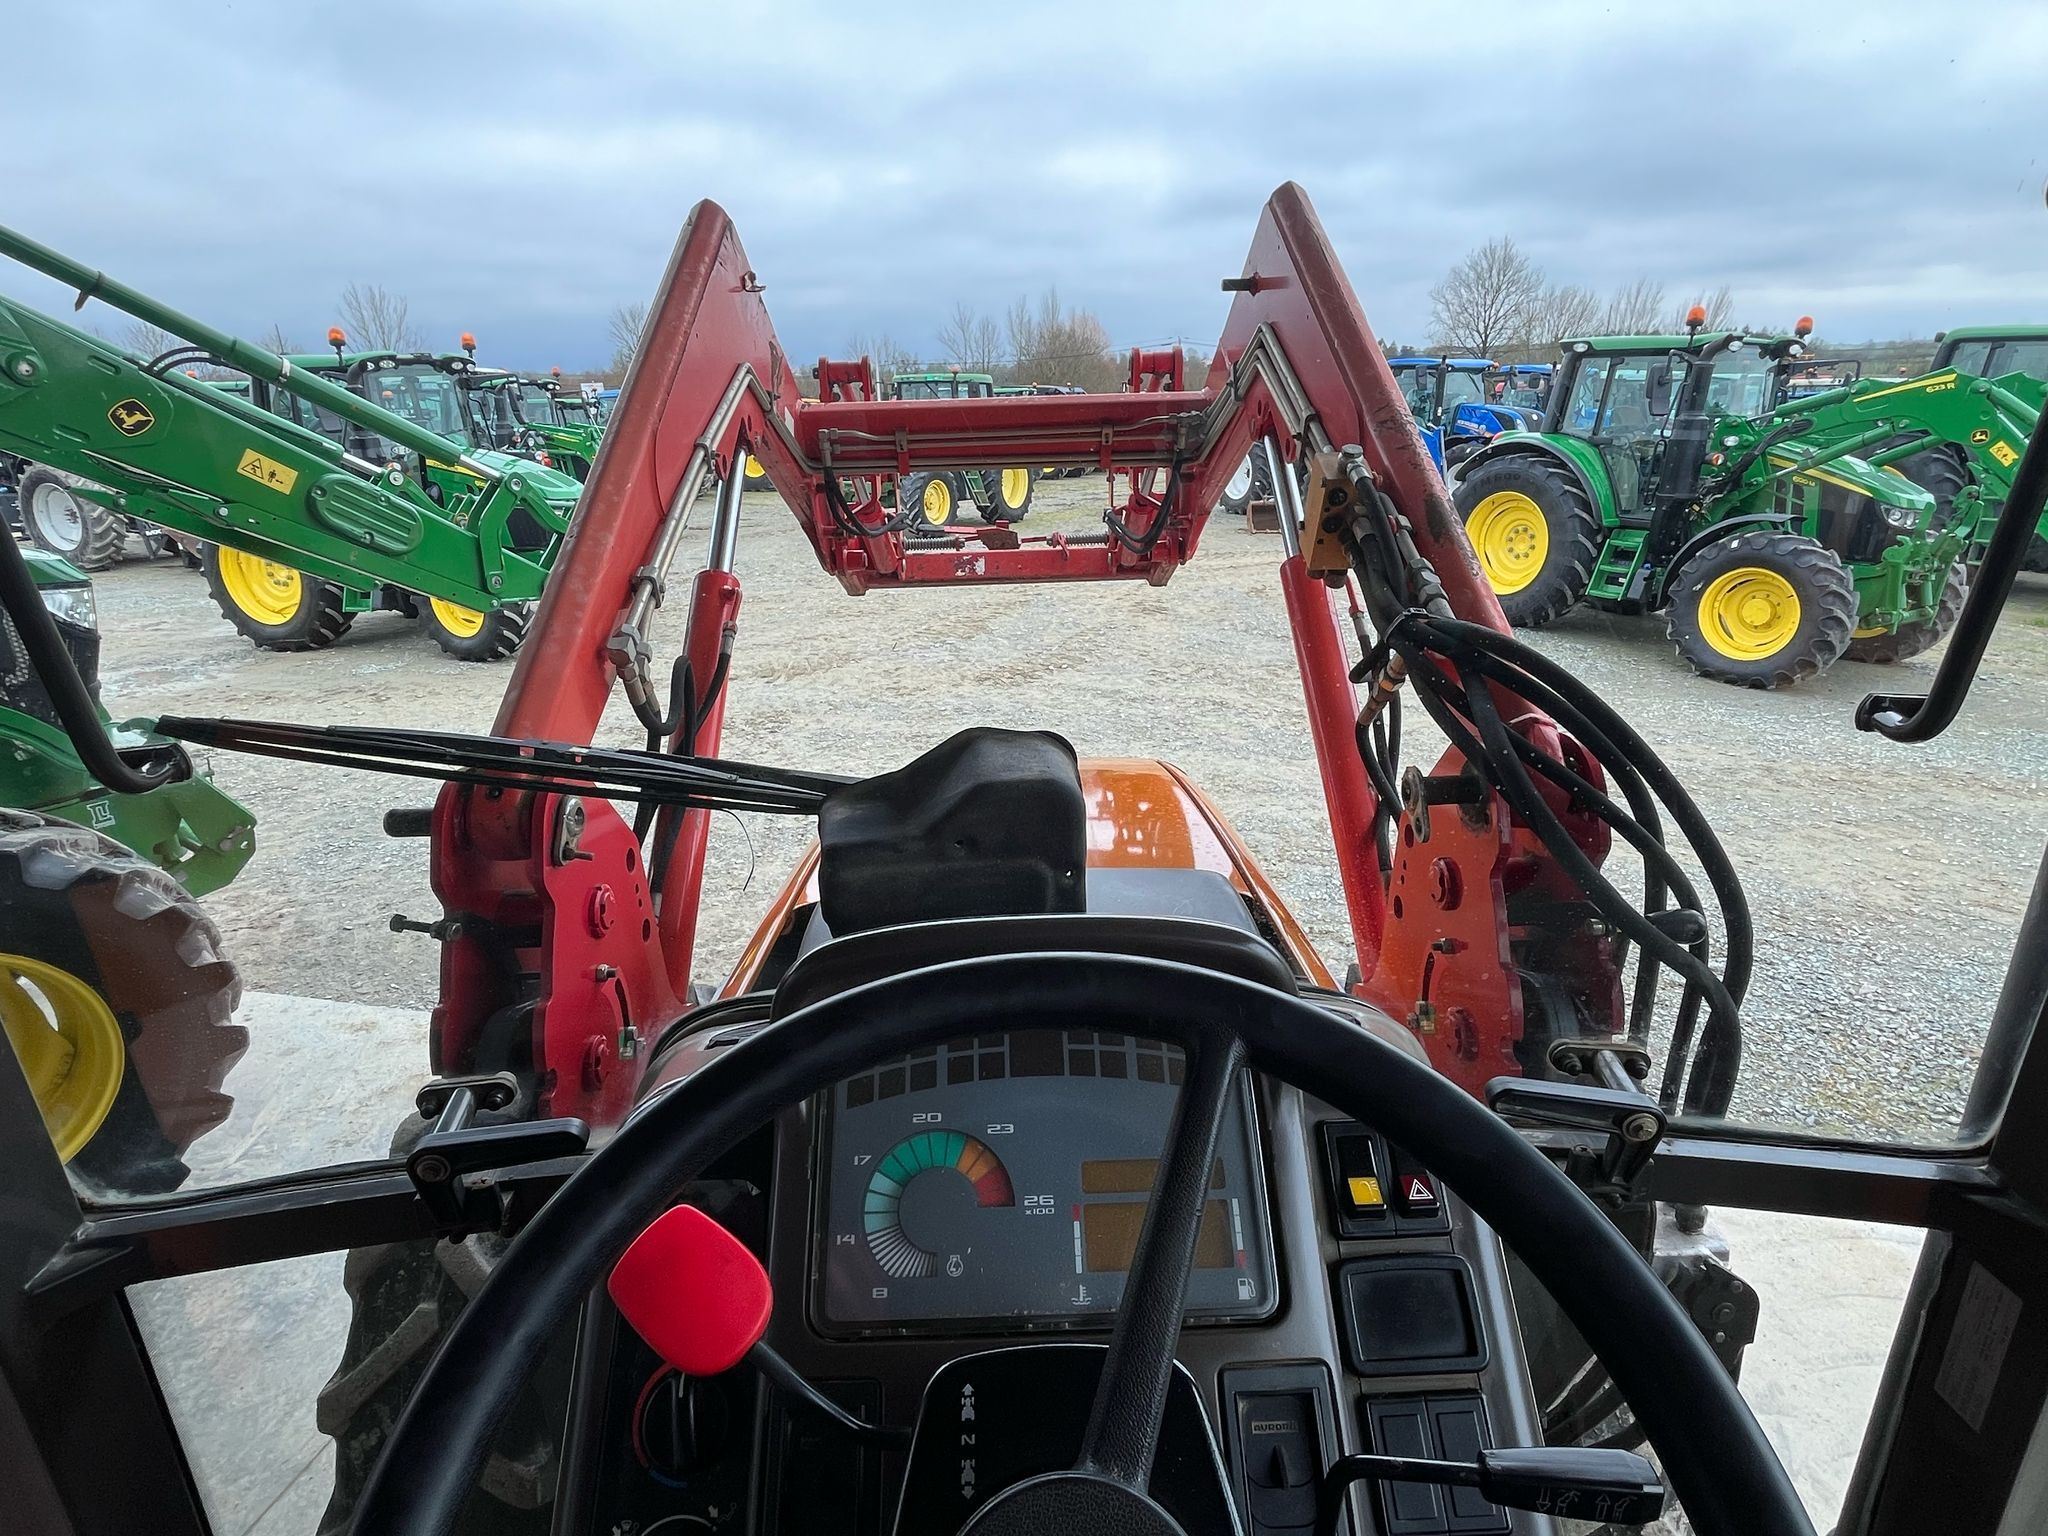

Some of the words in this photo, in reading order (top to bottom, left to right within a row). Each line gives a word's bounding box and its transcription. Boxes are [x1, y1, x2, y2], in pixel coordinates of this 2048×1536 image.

[912, 1113, 942, 1122] 20
[987, 1124, 1014, 1134] 23
[853, 1155, 872, 1165] 17
[1024, 1195, 1055, 1206] 26
[1024, 1207, 1055, 1215] x100
[836, 1234, 855, 1245] 14
[872, 1288, 888, 1298] 8
